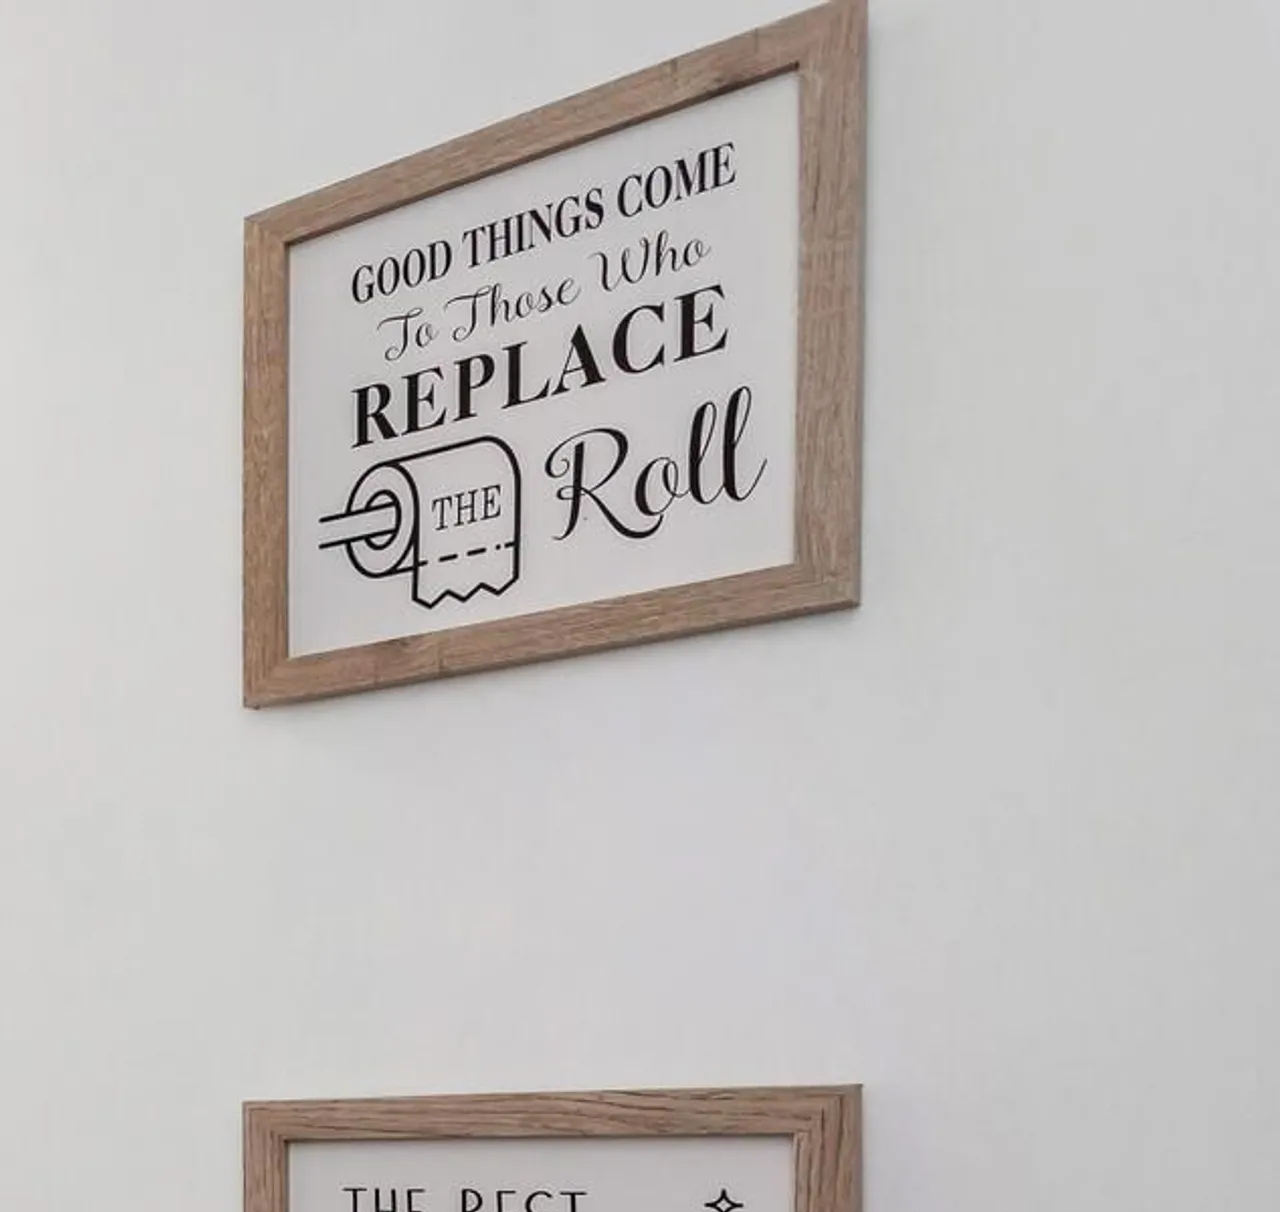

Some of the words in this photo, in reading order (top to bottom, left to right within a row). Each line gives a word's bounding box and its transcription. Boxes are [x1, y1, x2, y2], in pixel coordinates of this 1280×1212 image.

[351, 240, 453, 304] GOOD
[462, 187, 606, 268] THINGS
[616, 141, 737, 218] COME
[376, 306, 438, 362] To
[444, 276, 581, 343] Those
[593, 229, 712, 292] Who
[351, 284, 730, 449] REPLACE
[431, 484, 502, 532] THE
[544, 385, 768, 541] Roll
